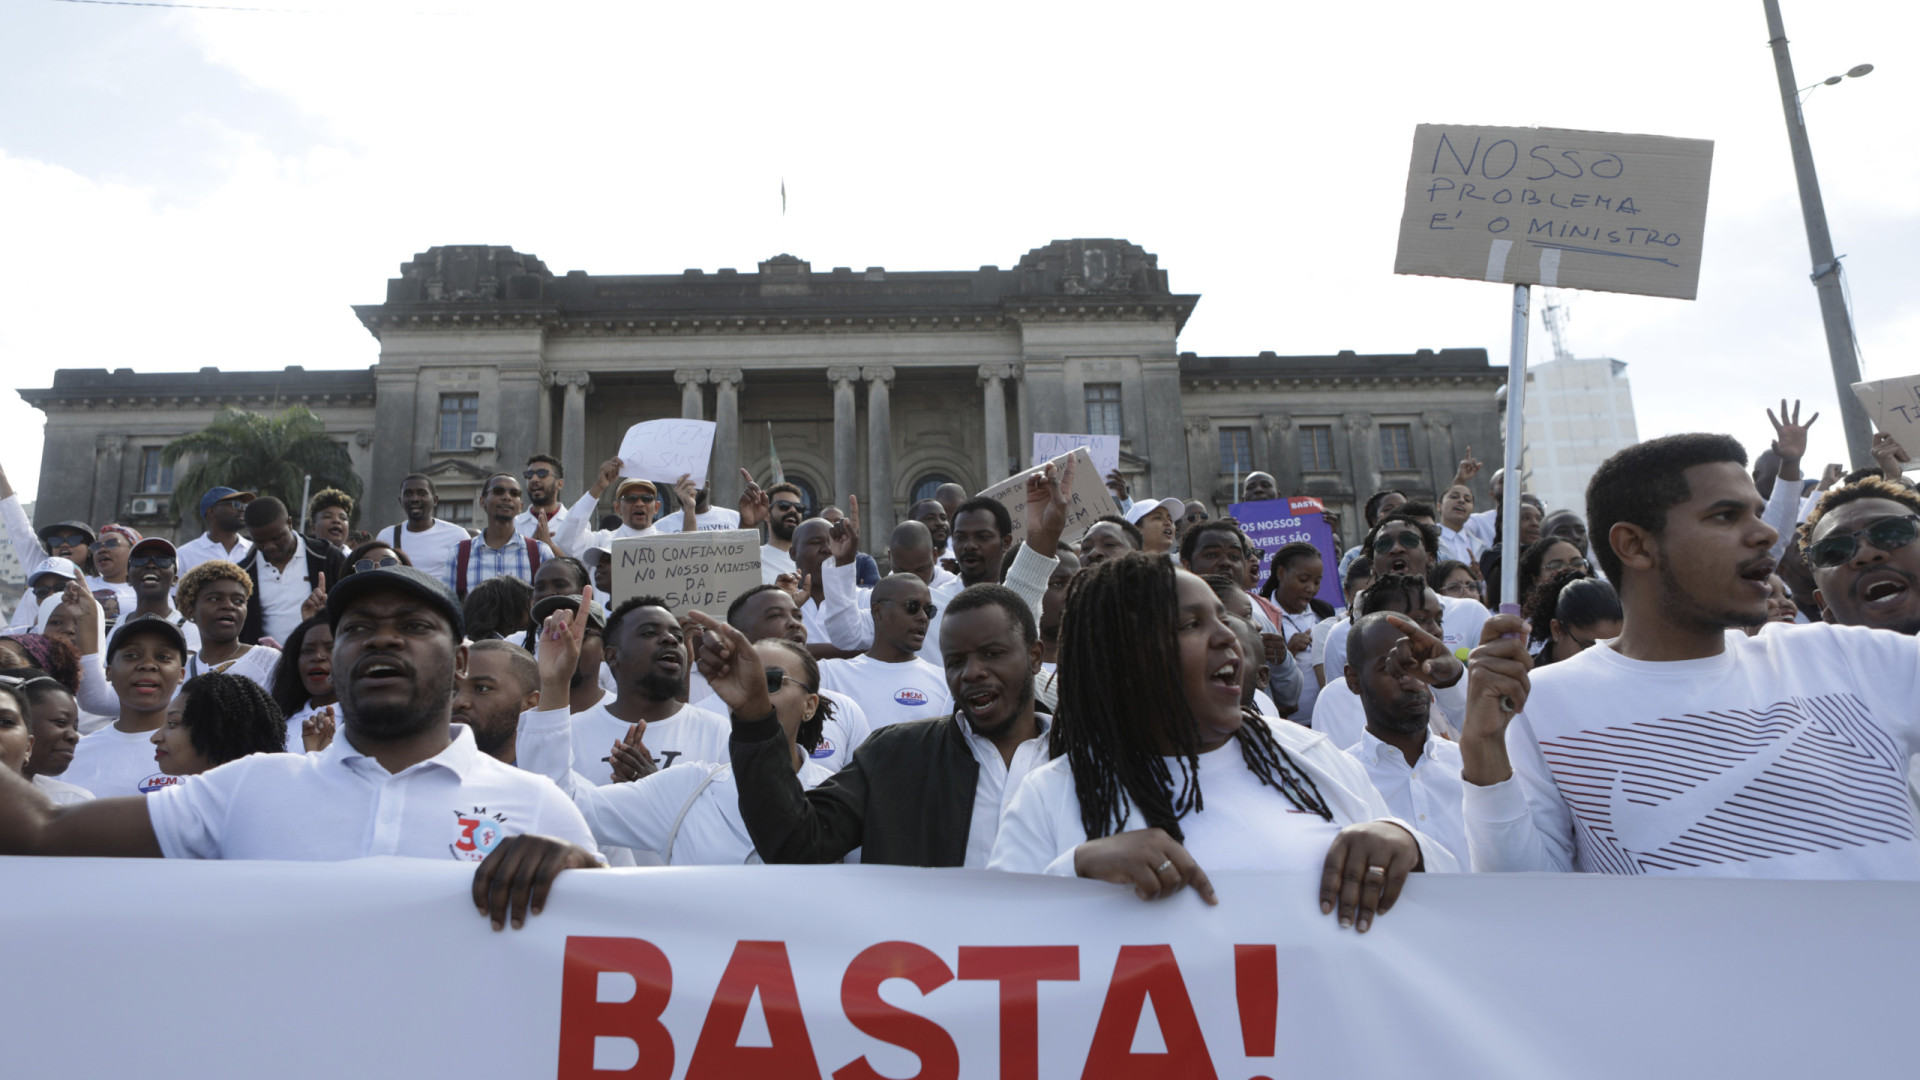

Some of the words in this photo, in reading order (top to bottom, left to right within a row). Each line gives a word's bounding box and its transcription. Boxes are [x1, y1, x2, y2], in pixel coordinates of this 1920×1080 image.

[1431, 132, 1624, 180] NOSSO
[1427, 177, 1641, 214] PROBLEMA
[1487, 216, 1510, 233] O
[1527, 217, 1681, 247] MINISTRO
[1240, 522, 1256, 532] OS
[1257, 517, 1302, 531] NOSSOS
[1252, 535, 1287, 548] EVERES
[1289, 531, 1311, 543] SÃO
[621, 547, 656, 568] NÃO
[662, 544, 744, 562] CONFIAMOS
[634, 567, 656, 583] NO
[666, 563, 709, 579] NOSSO
[686, 577, 706, 591] DA
[665, 590, 728, 609] SAÚDE
[557, 935, 1280, 1080] BASTA!
